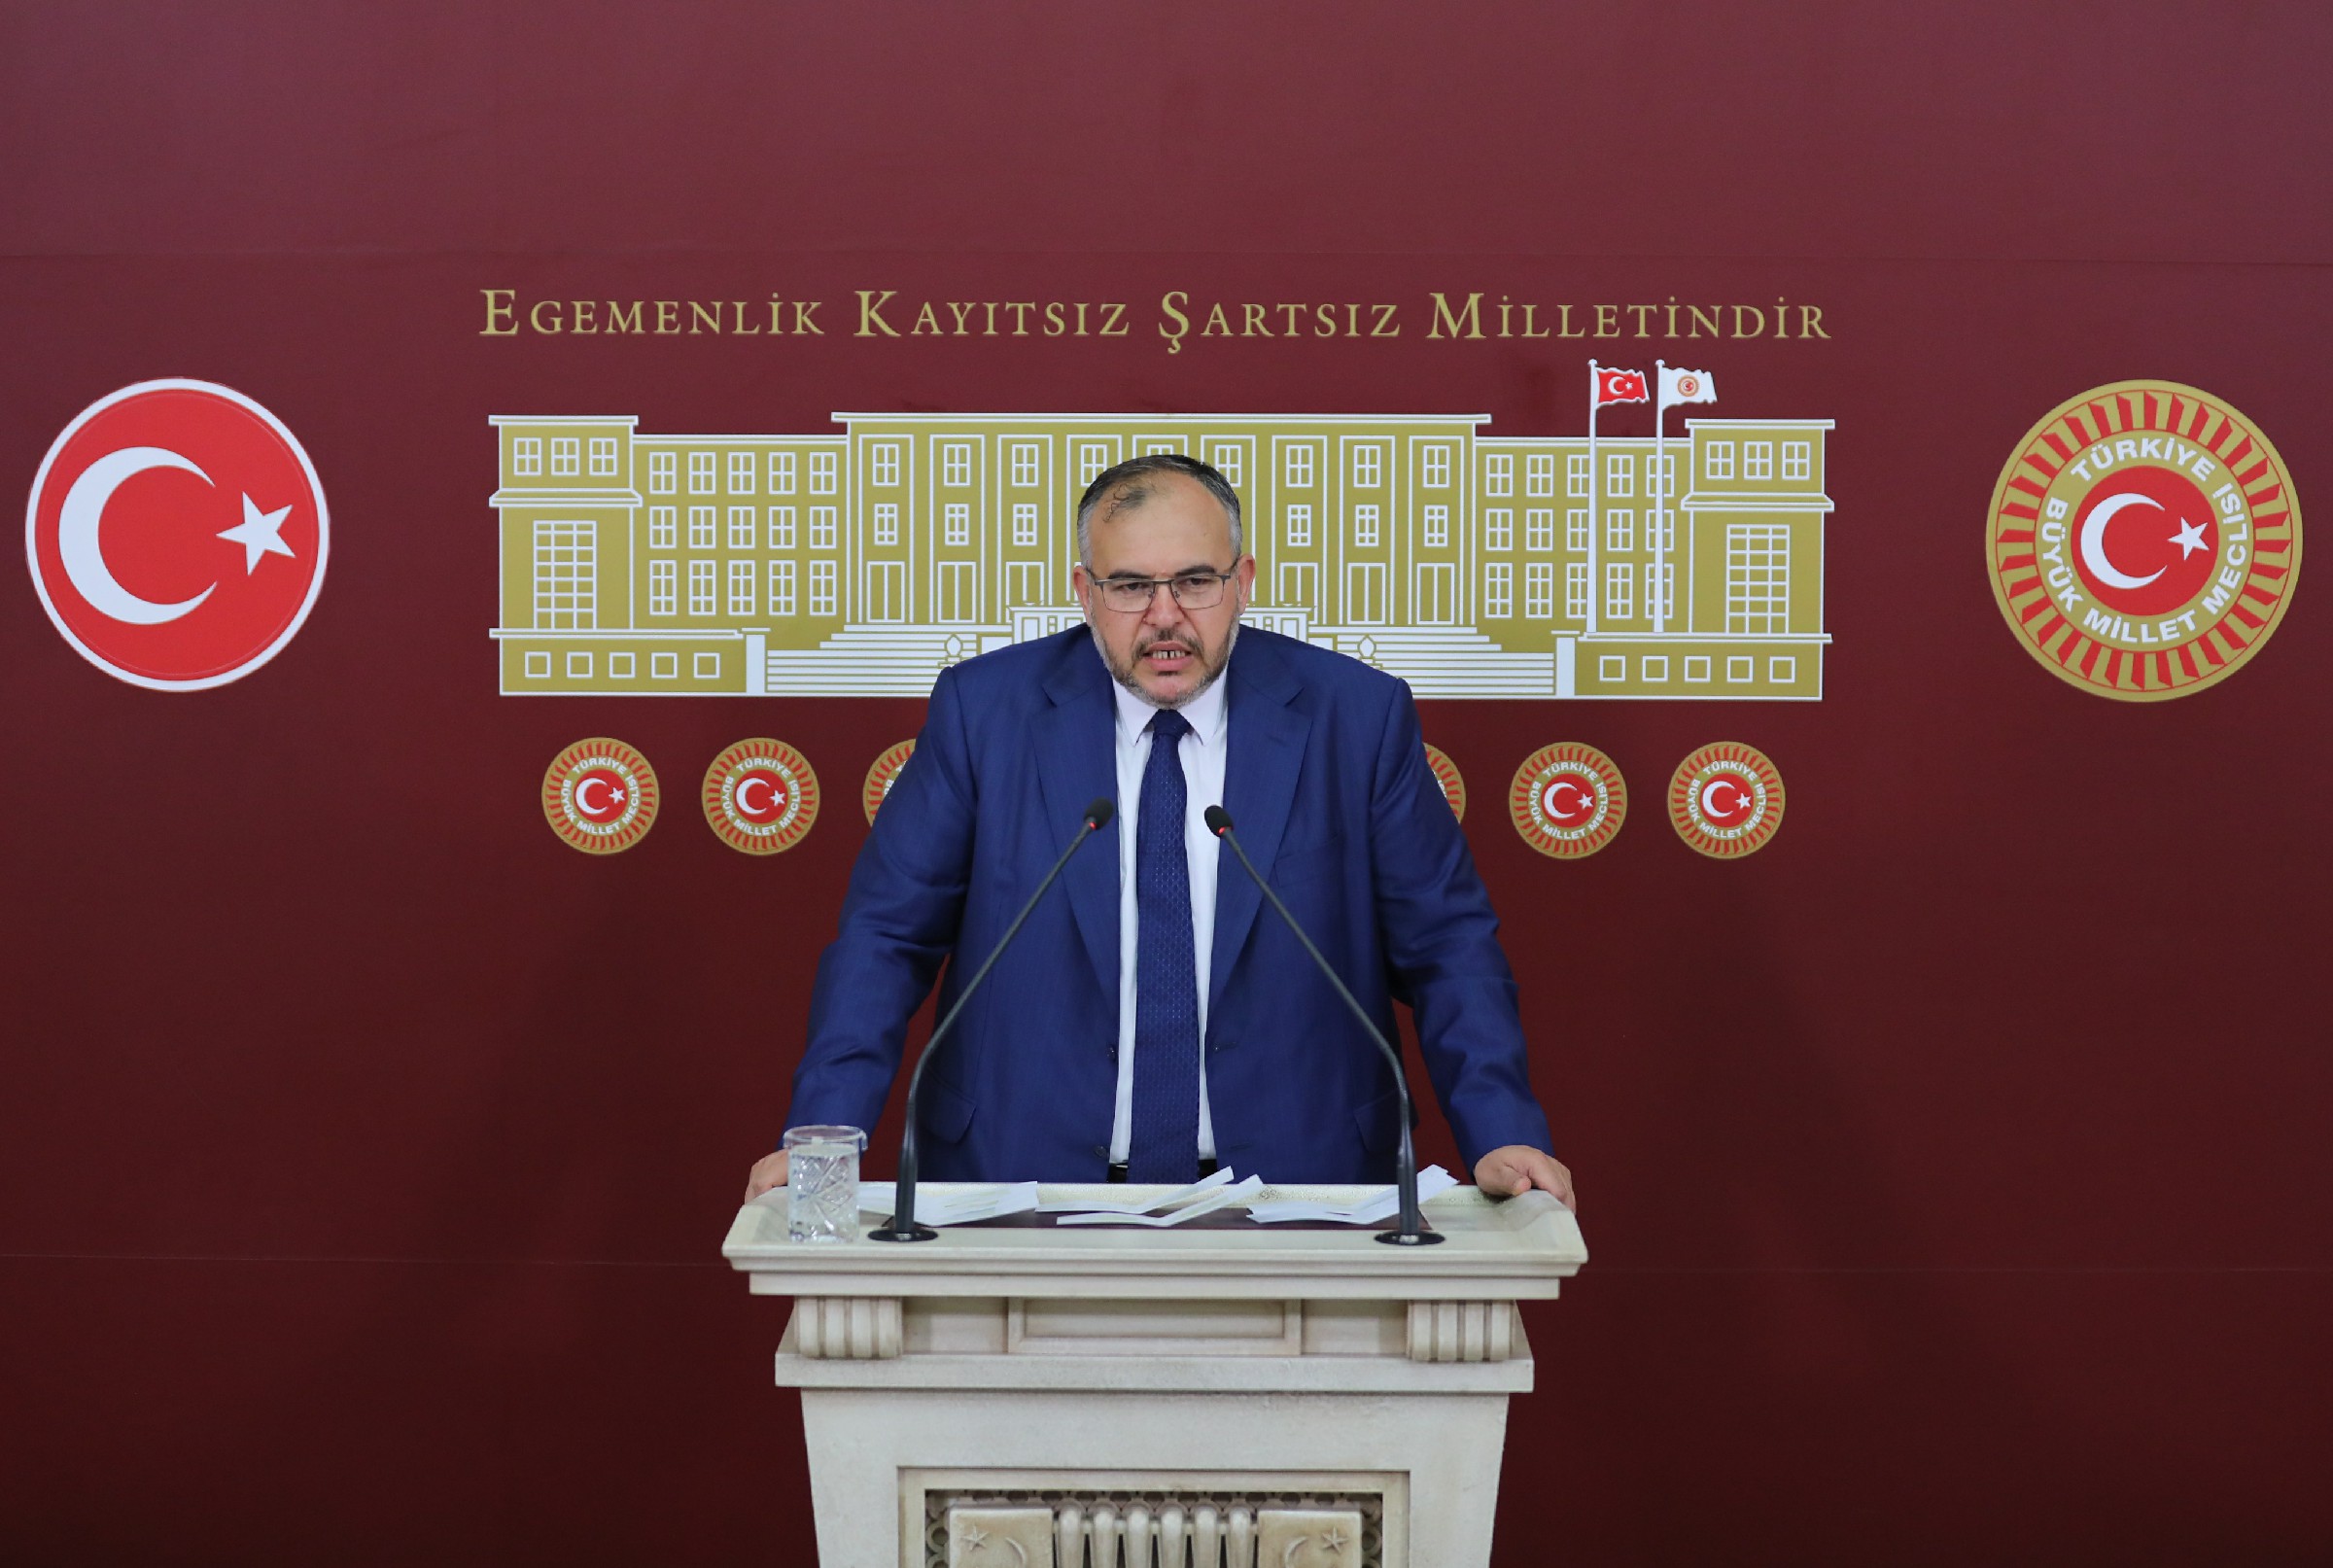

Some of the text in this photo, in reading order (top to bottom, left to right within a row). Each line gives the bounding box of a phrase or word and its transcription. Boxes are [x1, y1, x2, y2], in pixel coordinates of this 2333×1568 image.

[480, 290, 1831, 354] EGEMENLİK KAYITSIZ ŞARTSIZ MİLLETİNDİR
[2071, 437, 2215, 481] TÜRKİYE
[2041, 497, 2083, 612] BÜYÜK
[2083, 608, 2196, 644] MİLLET
[576, 820, 619, 834] MİLLET
[734, 819, 776, 835] MİLLET
[1543, 824, 1584, 839] MİLLET
[1699, 822, 1741, 838] MİLLET
